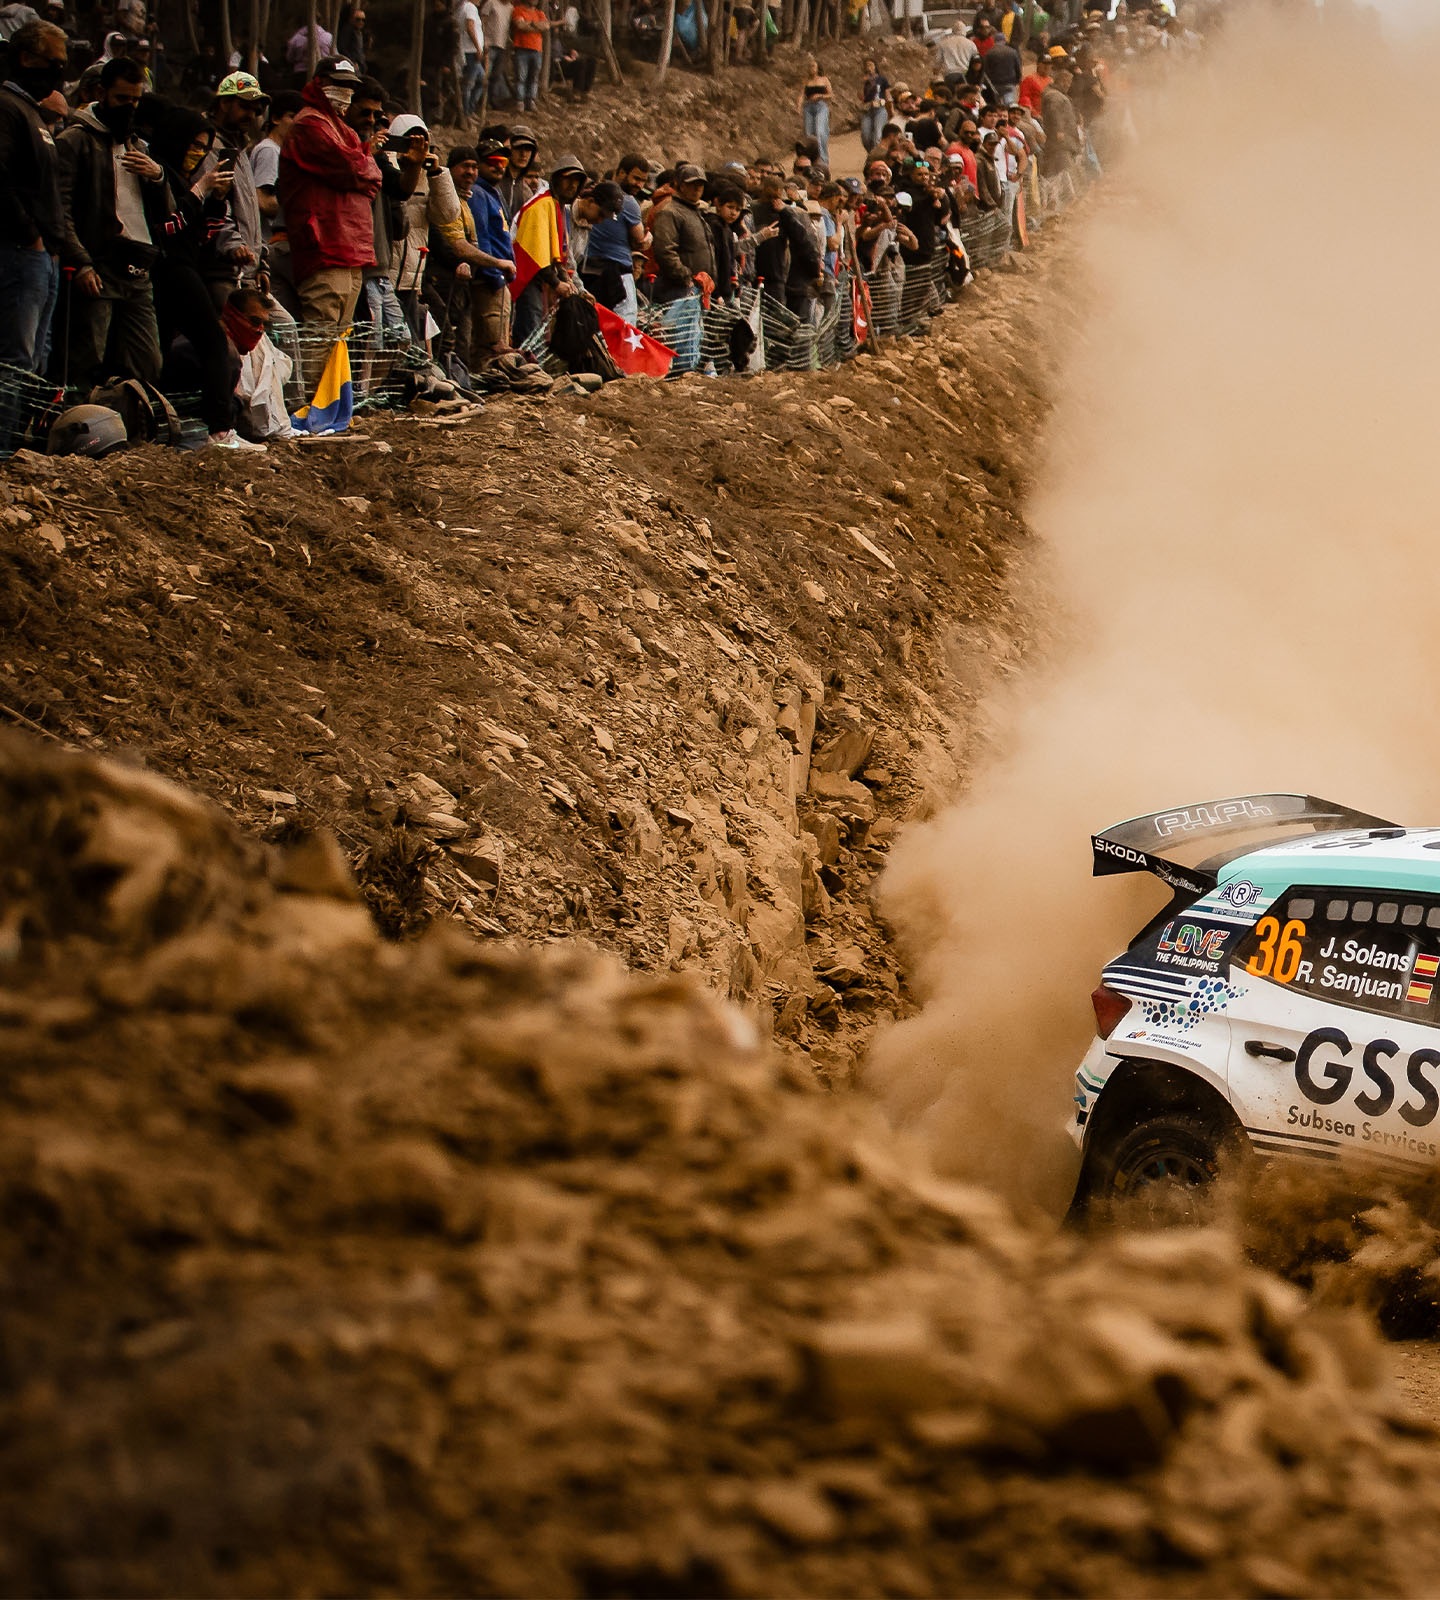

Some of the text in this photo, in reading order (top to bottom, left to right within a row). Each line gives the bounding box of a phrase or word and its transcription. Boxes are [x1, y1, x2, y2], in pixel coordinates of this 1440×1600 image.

[1218, 881, 1263, 906] ART
[1157, 921, 1230, 960] LOVE
[1245, 916, 1306, 984] 36
[1320, 936, 1411, 972] J. Solans
[1155, 952, 1220, 973] THE PHILIPPINES
[1296, 961, 1404, 1000] R. Sanjuan
[1287, 1104, 1437, 1157] Subsea Services
